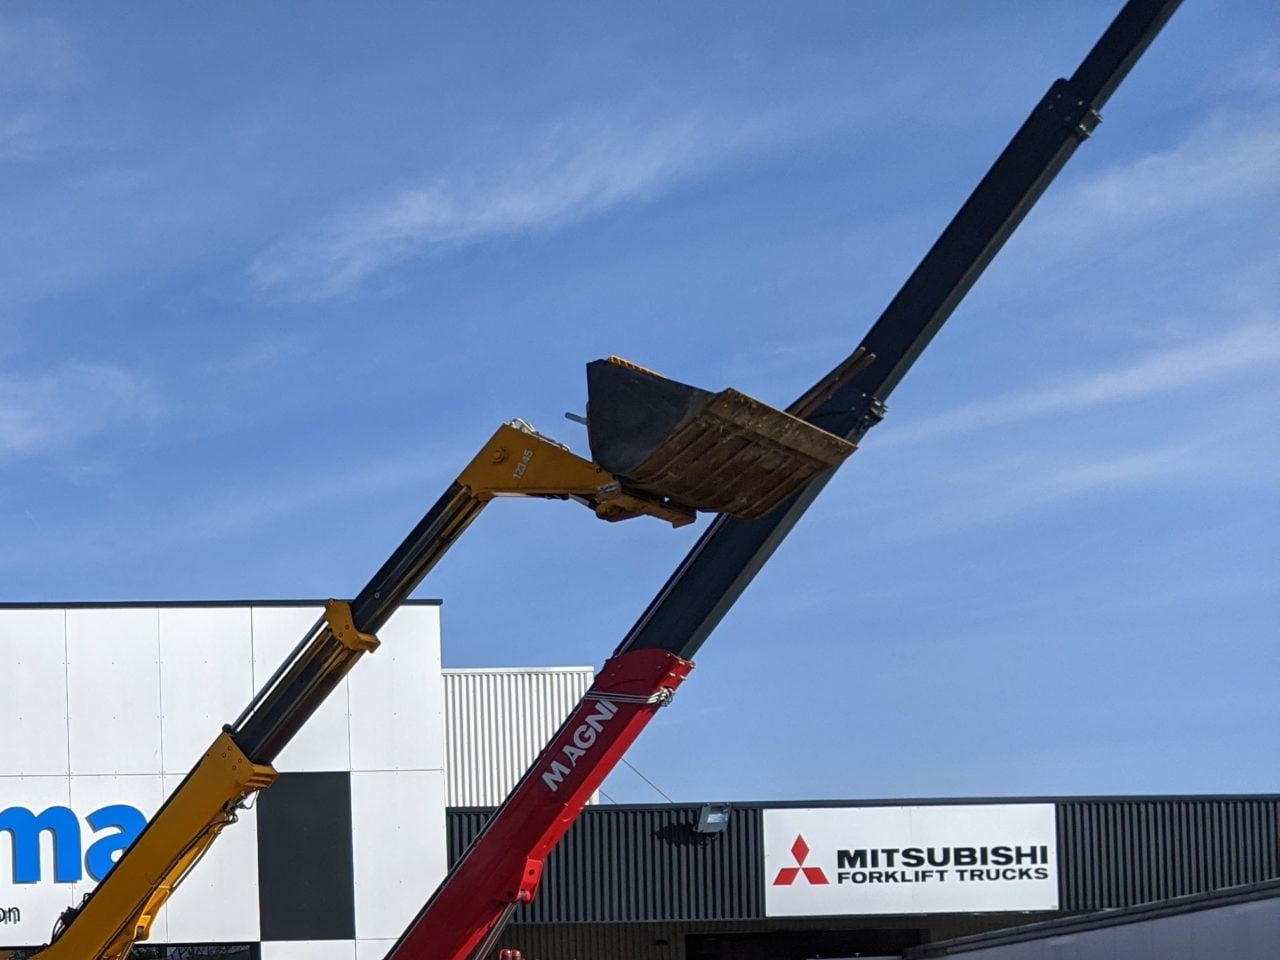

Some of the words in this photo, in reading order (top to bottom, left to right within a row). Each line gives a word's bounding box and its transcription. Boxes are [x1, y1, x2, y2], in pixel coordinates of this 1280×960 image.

[542, 699, 619, 792] MAGNI
[837, 845, 1048, 868] MITSUBISHI
[837, 869, 949, 885] FORKLIFT
[956, 867, 1049, 881] TRUCKS
